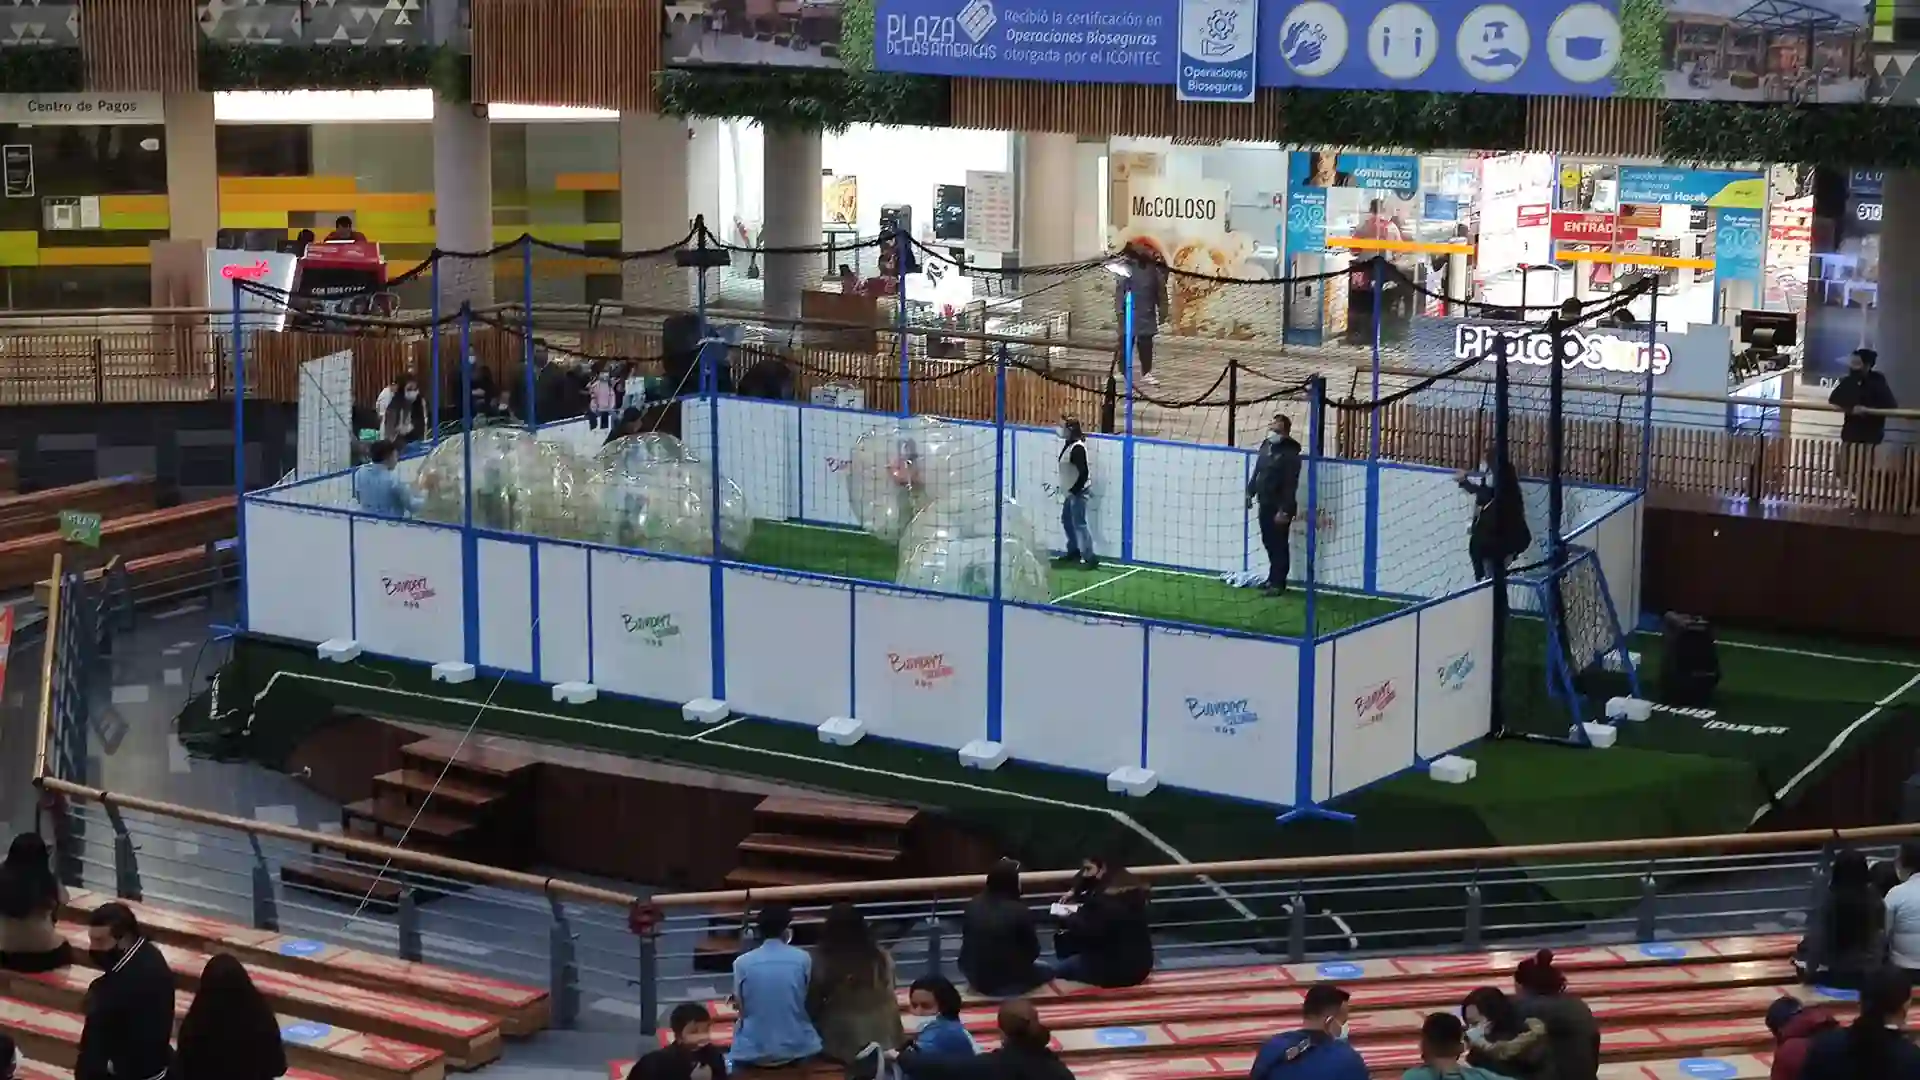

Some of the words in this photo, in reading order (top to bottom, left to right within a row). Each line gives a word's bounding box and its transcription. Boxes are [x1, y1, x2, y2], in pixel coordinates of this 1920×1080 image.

[1004, 8, 1048, 24] Recibió
[1052, 11, 1063, 25] la
[1066, 11, 1143, 27] certificación
[1146, 15, 1163, 26] en
[887, 14, 955, 42] PLAZA
[1006, 28, 1083, 45] Operaciones
[1087, 30, 1157, 48] Bioseguras
[886, 40, 901, 55] DE
[1003, 48, 1061, 65] otorgada
[1064, 51, 1086, 66] por
[1090, 49, 1102, 63] el
[1106, 51, 1163, 66] ICONTEC
[1183, 66, 1248, 79] Operaciones
[1187, 80, 1244, 93] Bioseguras
[28, 99, 72, 112] Centro
[76, 101, 93, 112] de
[97, 100, 137, 114] Pagos
[1131, 195, 1217, 220] McCOLOSO
[1563, 220, 1624, 235] ENTRAD
